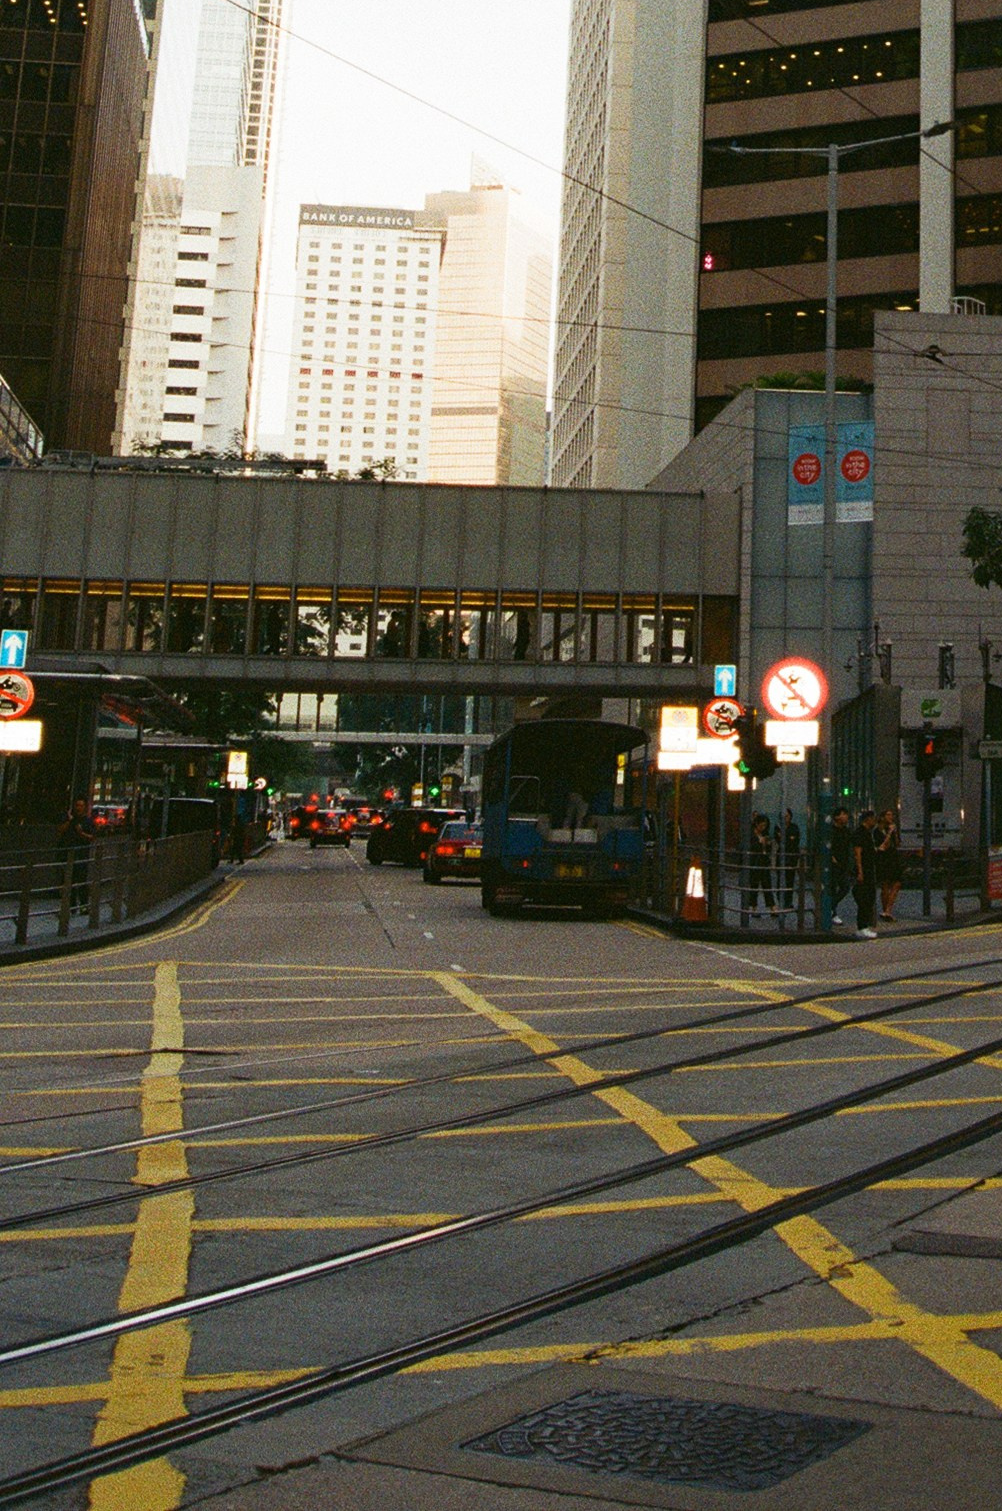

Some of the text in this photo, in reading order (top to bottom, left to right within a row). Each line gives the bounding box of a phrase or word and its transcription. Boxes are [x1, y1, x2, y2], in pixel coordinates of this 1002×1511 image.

[302, 212, 413, 226] BANK OF AMERICA
[799, 471, 815, 483] city
[847, 468, 864, 479] city
